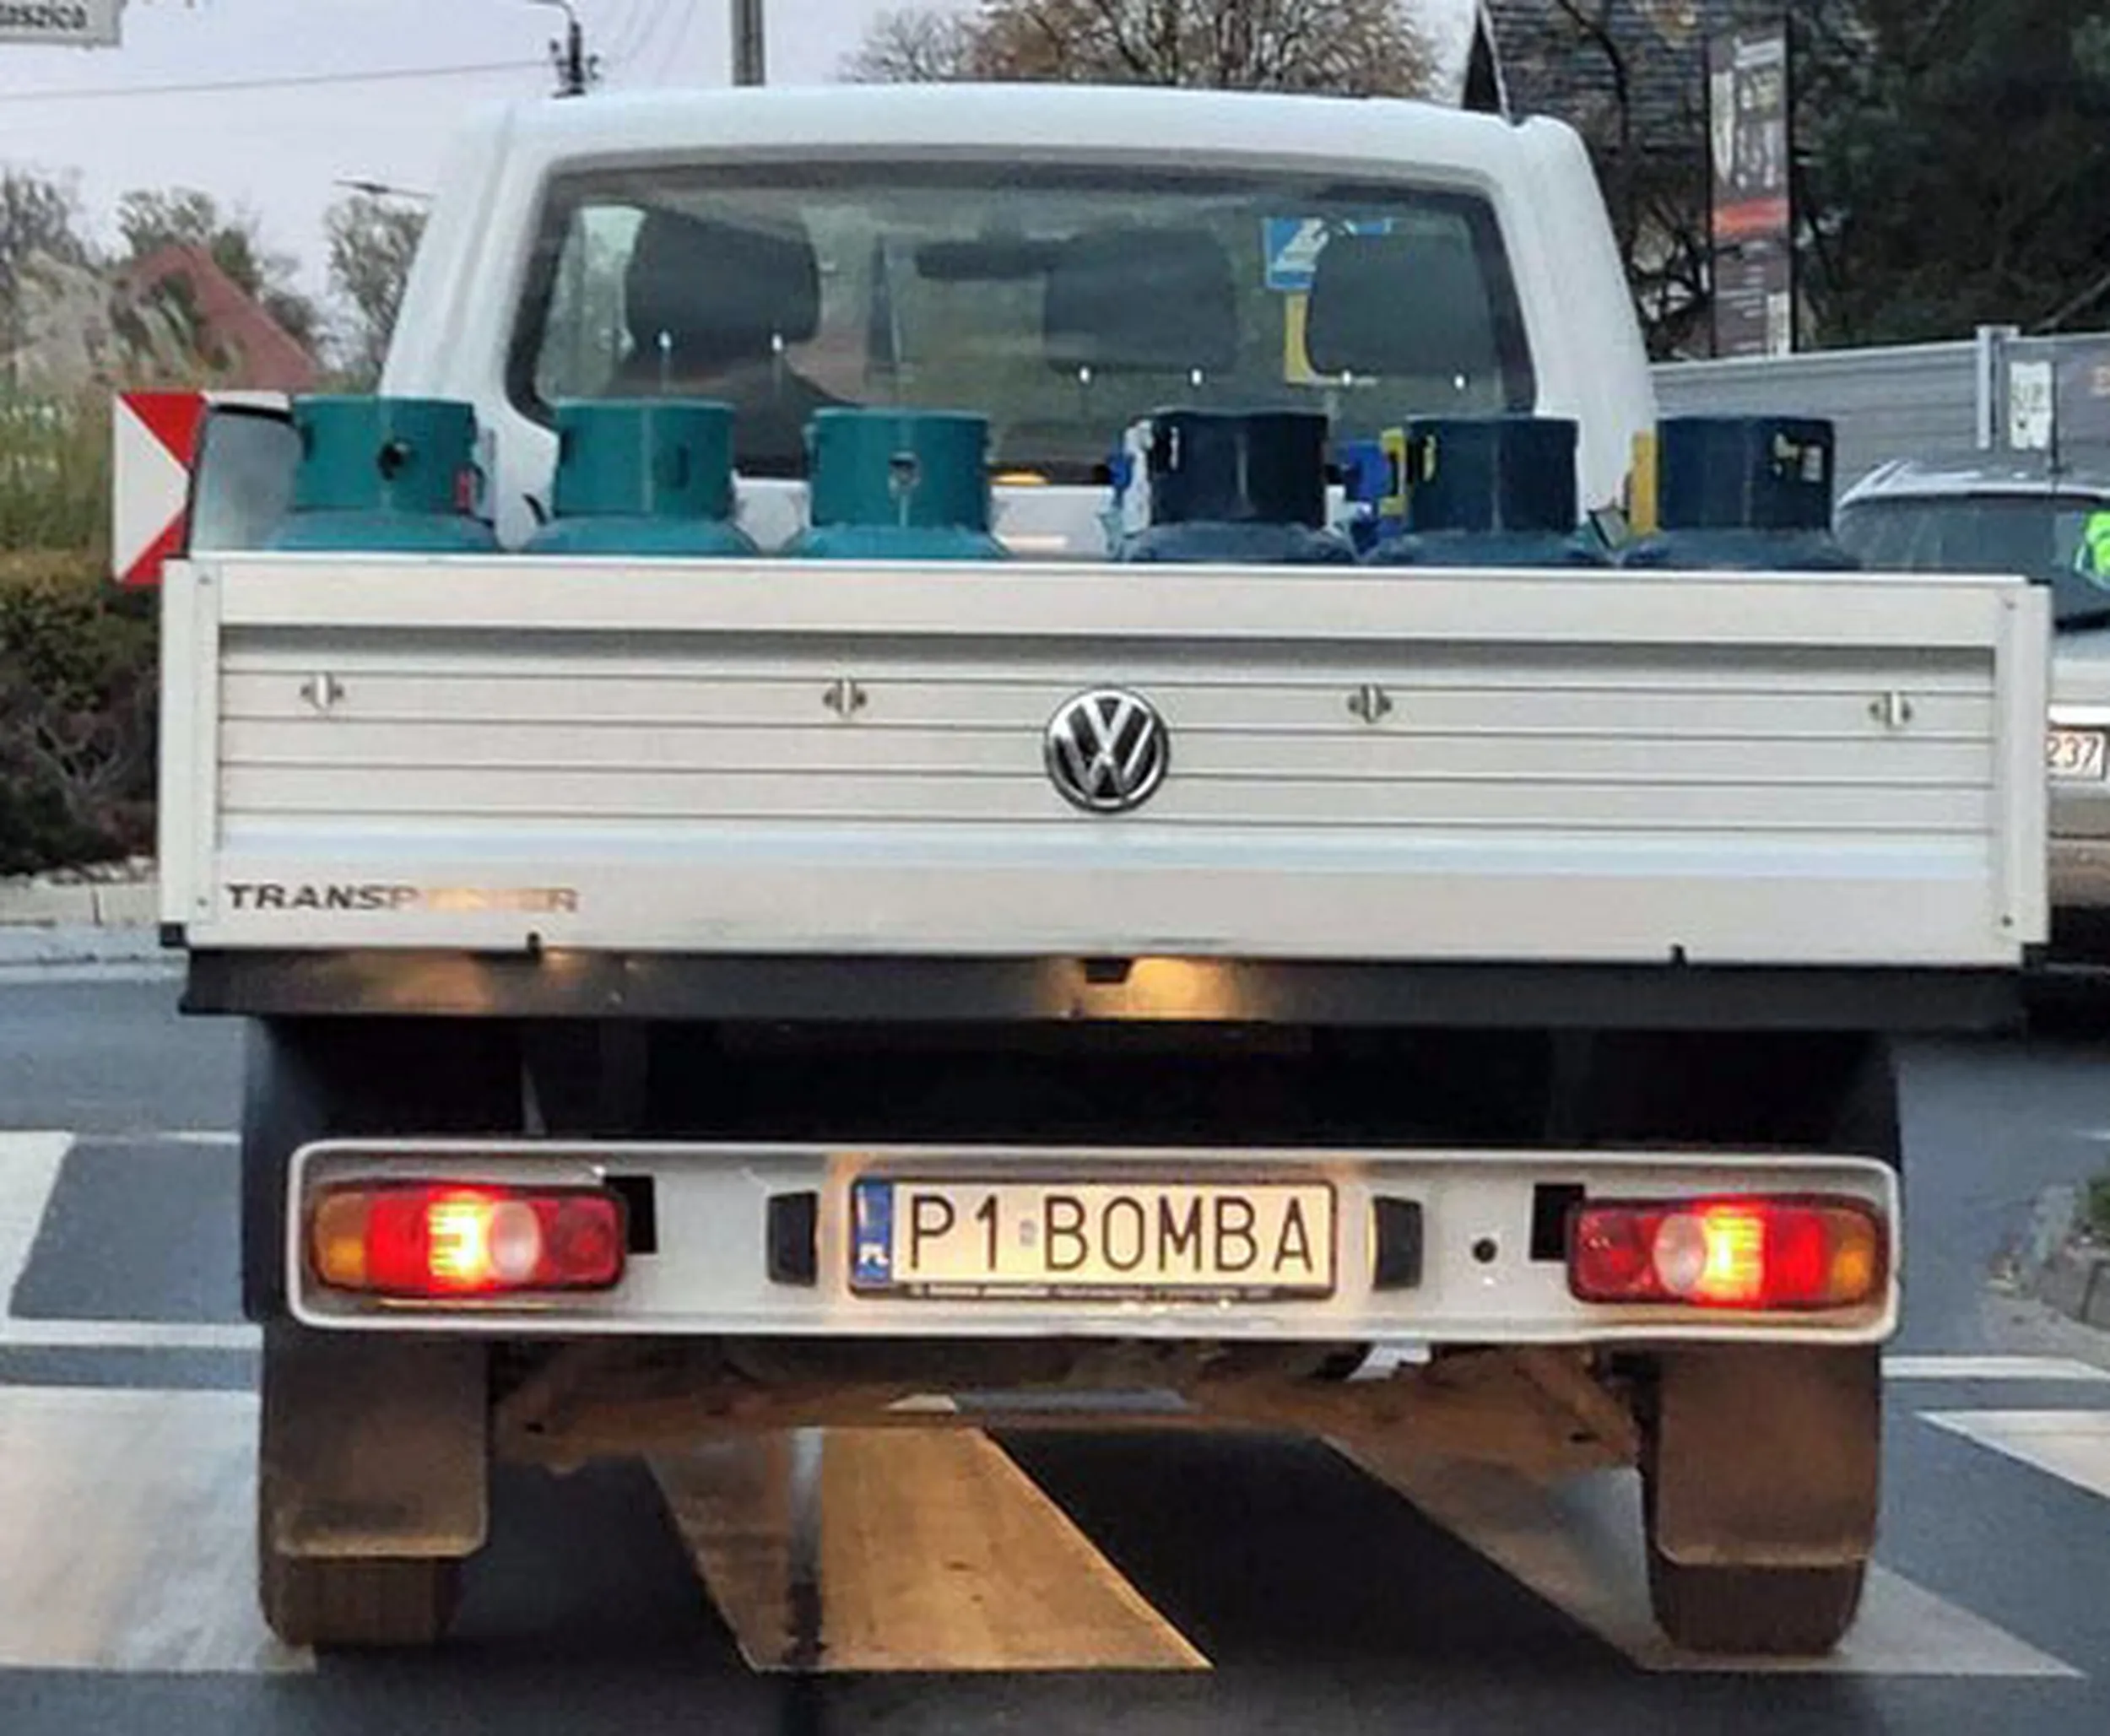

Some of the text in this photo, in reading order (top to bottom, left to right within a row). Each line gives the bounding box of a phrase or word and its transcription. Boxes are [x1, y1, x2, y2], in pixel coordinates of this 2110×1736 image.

[225, 883, 580, 911] TRANSPR
[911, 1193, 1313, 1273] P1 BOMBA
